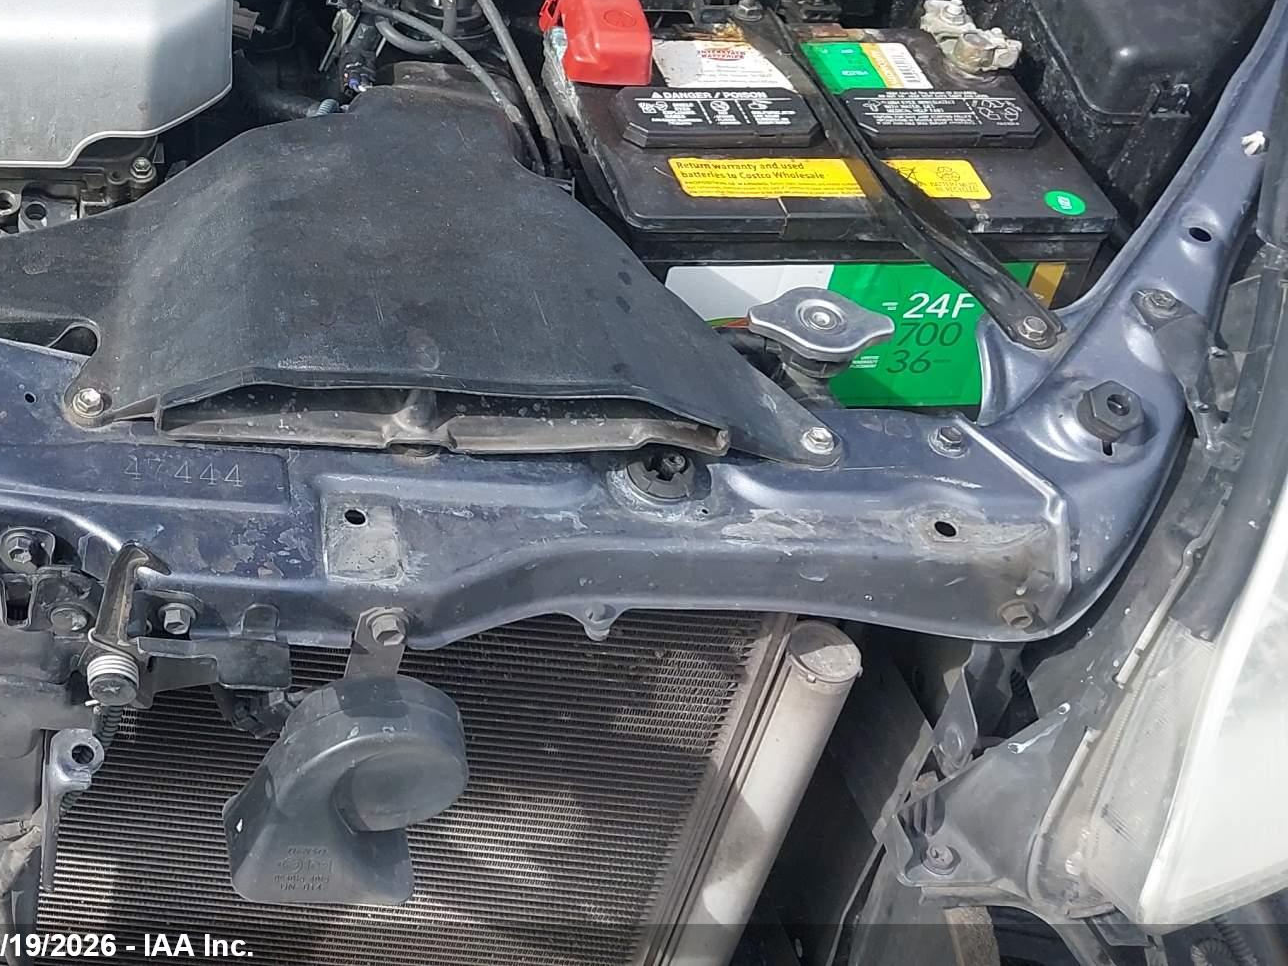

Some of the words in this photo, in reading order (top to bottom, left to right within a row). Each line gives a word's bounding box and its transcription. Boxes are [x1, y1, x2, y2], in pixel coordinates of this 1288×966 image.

[675, 161, 712, 170] Return
[712, 163, 757, 172] warranty
[760, 161, 778, 170] and
[780, 161, 804, 170] used
[681, 170, 726, 179] batteries
[727, 171, 737, 179] to
[739, 171, 772, 179] Costco
[772, 171, 825, 180] Wholesale
[902, 293, 976, 319] 24F
[896, 322, 963, 347] 700
